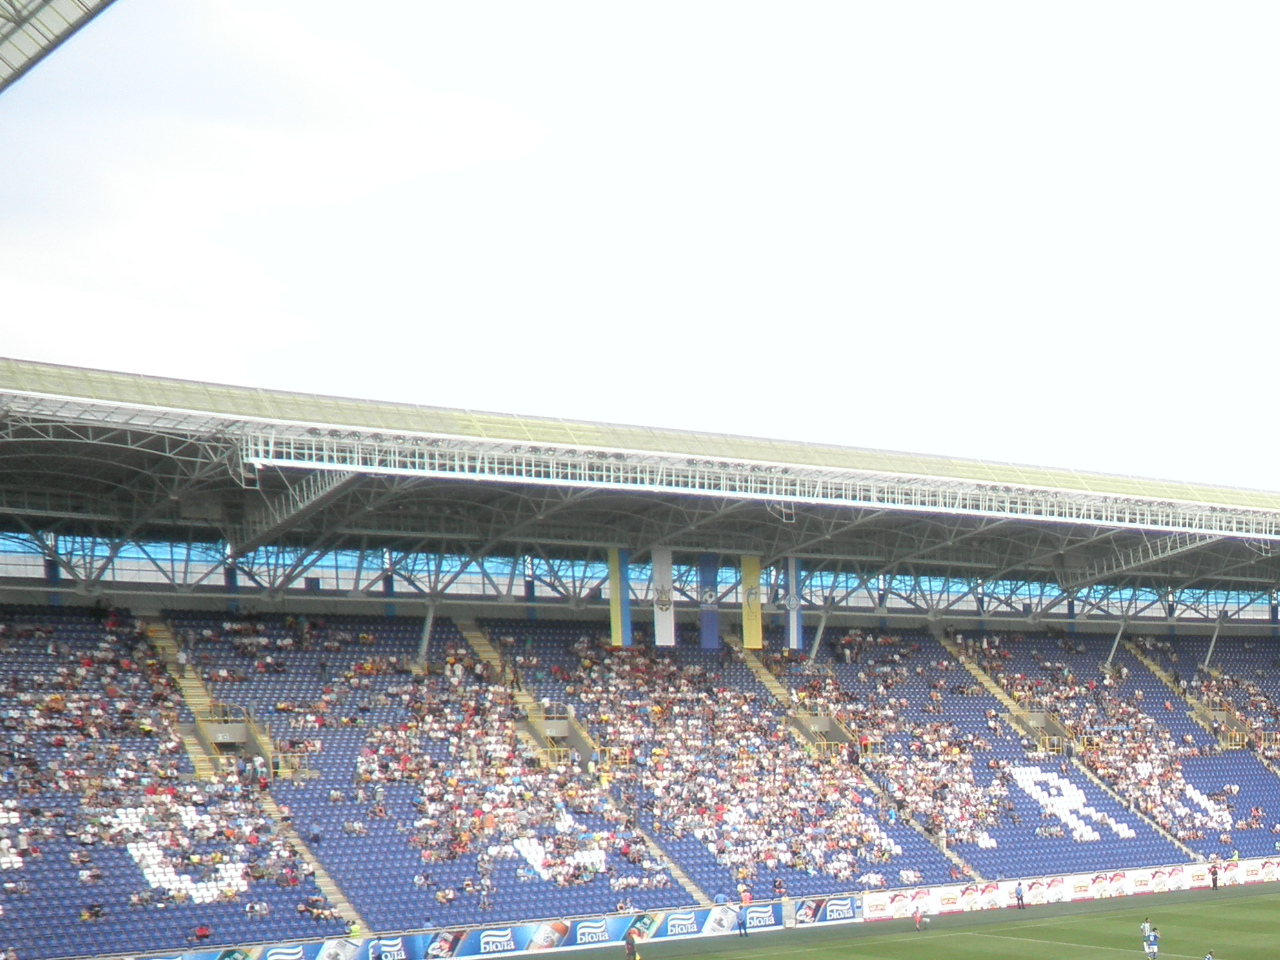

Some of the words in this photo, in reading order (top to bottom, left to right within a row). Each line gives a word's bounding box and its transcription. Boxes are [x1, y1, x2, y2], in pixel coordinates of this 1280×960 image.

[577, 926, 609, 943] Біола
[667, 917, 698, 935] Біола
[480, 935, 515, 953] Біола
